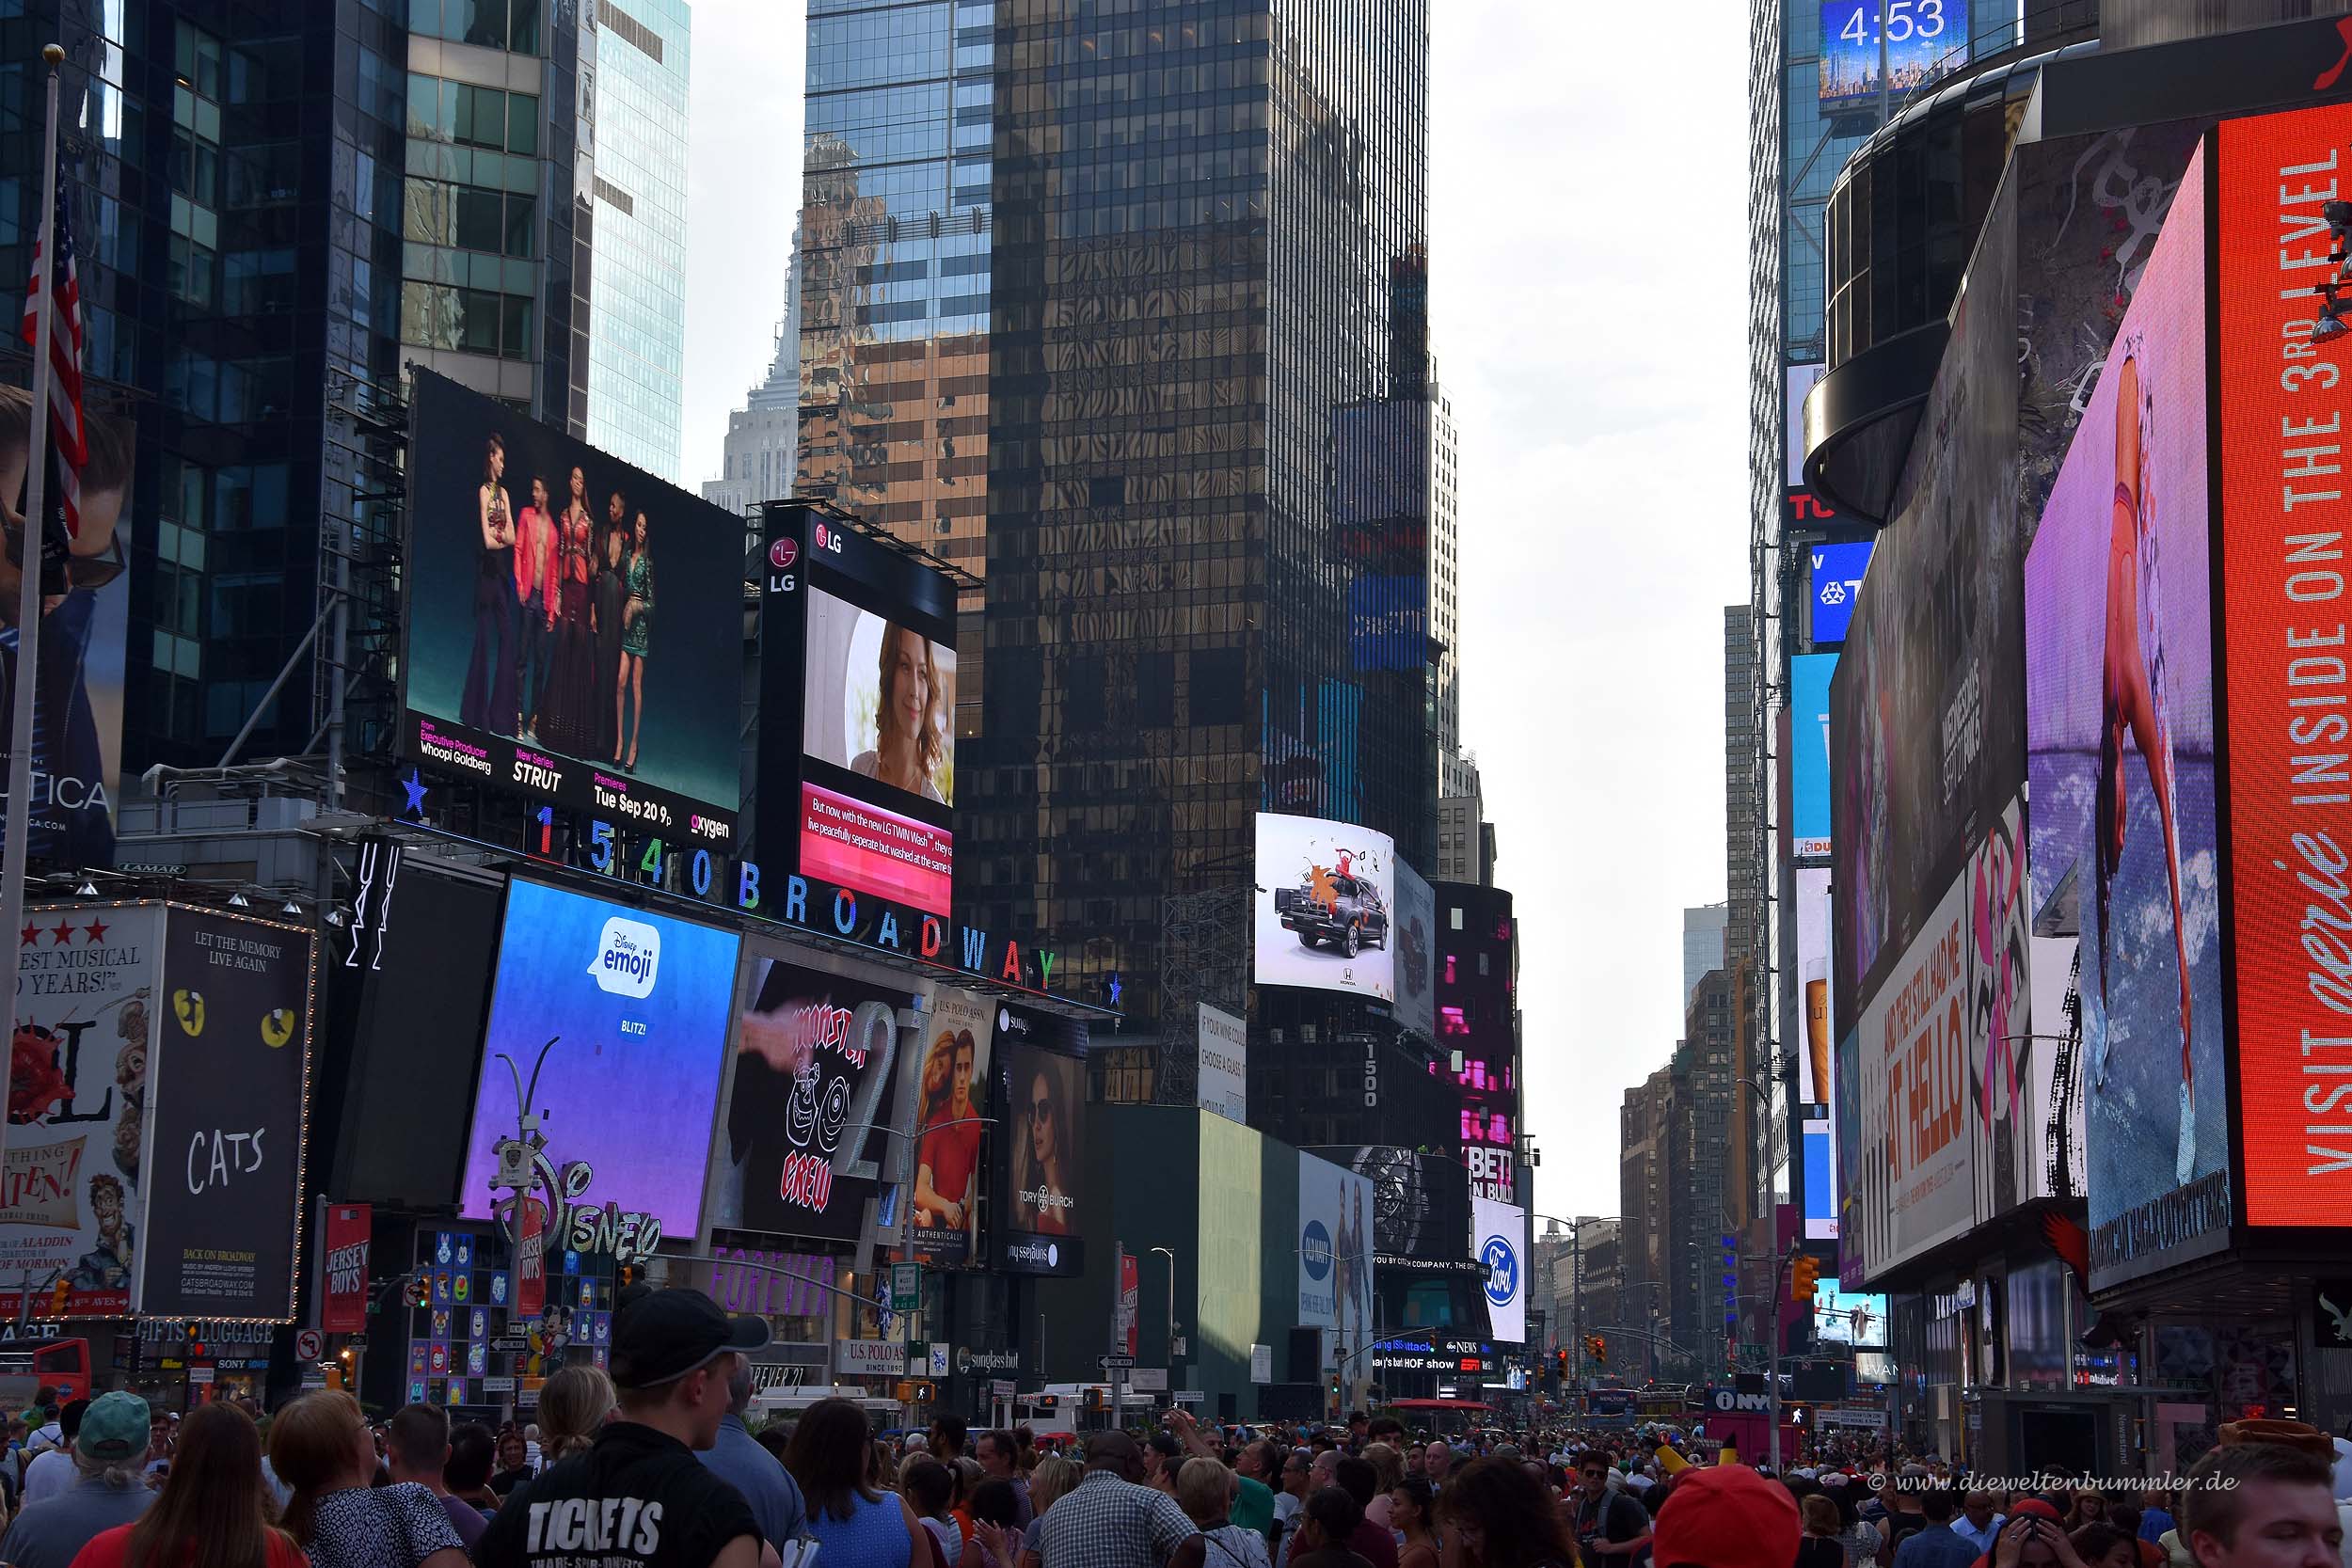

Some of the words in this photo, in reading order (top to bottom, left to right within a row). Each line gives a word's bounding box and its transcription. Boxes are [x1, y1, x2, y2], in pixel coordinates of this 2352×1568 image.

[1840, 0, 1945, 45] 4:53
[2280, 149, 2339, 299] LEVEL
[2282, 320, 2340, 391] 3RD
[2283, 410, 2342, 512] THE
[827, 531, 841, 554] LG
[2284, 531, 2345, 602] ON
[771, 575, 795, 593] LG
[421, 721, 435, 731] From
[2287, 623, 2350, 804] INSIDE
[421, 729, 453, 749] Executive
[454, 740, 487, 759] Producer
[421, 741, 452, 762] Whoopi
[453, 751, 491, 775] Goldberg
[516, 749, 530, 763] New
[532, 753, 554, 769] Series
[513, 761, 562, 792] STRUT
[595, 772, 627, 792] Premieres
[29, 770, 110, 814] TICA
[595, 785, 616, 808] Tue
[619, 794, 642, 818] Sep
[644, 801, 658, 821] 20
[691, 815, 729, 839] oxygen
[813, 799, 824, 814] But
[826, 806, 841, 821] now,
[842, 811, 856, 825] with
[857, 814, 867, 829] the
[868, 820, 882, 832] new
[883, 821, 892, 835] LG
[892, 824, 910, 843] TWIN
[935, 839, 947, 857] they
[808, 816, 818, 831] live
[820, 824, 850, 847] peacefully
[852, 832, 879, 850] seperate
[880, 839, 891, 854] but
[891, 846, 913, 863] washed
[914, 853, 920, 864] at
[921, 854, 932, 869] the
[932, 860, 947, 874] same
[123, 863, 180, 874] LAMAR
[739, 860, 1055, 990] BROADWAY
[195, 931, 214, 945] LET
[215, 935, 236, 951] THE
[238, 940, 281, 959] MEMORY
[19, 952, 52, 971] EST
[58, 946, 140, 970] MUSICAL
[209, 950, 232, 967] LIVE
[234, 955, 266, 973] AGAIN
[604, 949, 652, 984] emoji
[1884, 1003, 1897, 1057] AND
[1898, 982, 1913, 1042] THEY
[1913, 957, 1931, 1022] STILL
[1931, 933, 1948, 1006] HAD
[1948, 916, 1960, 984] ME
[952, 1002, 967, 1017] POLO
[621, 1020, 646, 1035] BLITZ!
[1202, 1049, 1222, 1071] CHOOSE
[1227, 1058, 1241, 1077] GLASS
[1364, 1044, 1377, 1107] 1500
[2301, 1028, 2352, 1176] VISIT
[1888, 1057, 1902, 1184] AT
[5, 1147, 64, 1163] THING
[188, 1128, 265, 1195] CATS
[780, 1149, 833, 1213] CREW
[1019, 1190, 1038, 1203] TORY
[1049, 1195, 1073, 1209] BURCH
[19, 1237, 73, 1248] ALADDIN
[520, 1232, 544, 1259] JERSEY
[917, 1229, 963, 1243] AUTHENTICALLY
[183, 1248, 203, 1259] BACK
[204, 1250, 216, 1260] ON
[217, 1250, 256, 1263] BROADWAY
[326, 1243, 370, 1273] JERSEY
[1019, 1243, 1048, 1263] sunglass
[1305, 1236, 1316, 1263] OLD
[1316, 1240, 1328, 1265] NAVY
[522, 1257, 540, 1279] BOYS
[1412, 1260, 1453, 1270] COMPANY,
[1488, 1245, 1512, 1293] Ford
[181, 1278, 255, 1290] CATSBROADWAY.COM
[331, 1269, 360, 1294] BOYS
[707, 1247, 833, 1315] FOREVER
[92, 1297, 117, 1307] AVES
[135, 1320, 185, 1342] GIFTS
[197, 1322, 274, 1344] LUGGAGE
[850, 1343, 866, 1360] U.S.
[867, 1344, 891, 1361] POLO
[1456, 1341, 1477, 1354] NEWS
[217, 1359, 246, 1370] SONY
[866, 1364, 885, 1372] SINCE
[971, 1349, 1004, 1374] sunglass
[1005, 1350, 1019, 1370] hut
[1405, 1358, 1424, 1370] HOF
[1426, 1358, 1454, 1370] show
[527, 1497, 664, 1556] TICKETS
